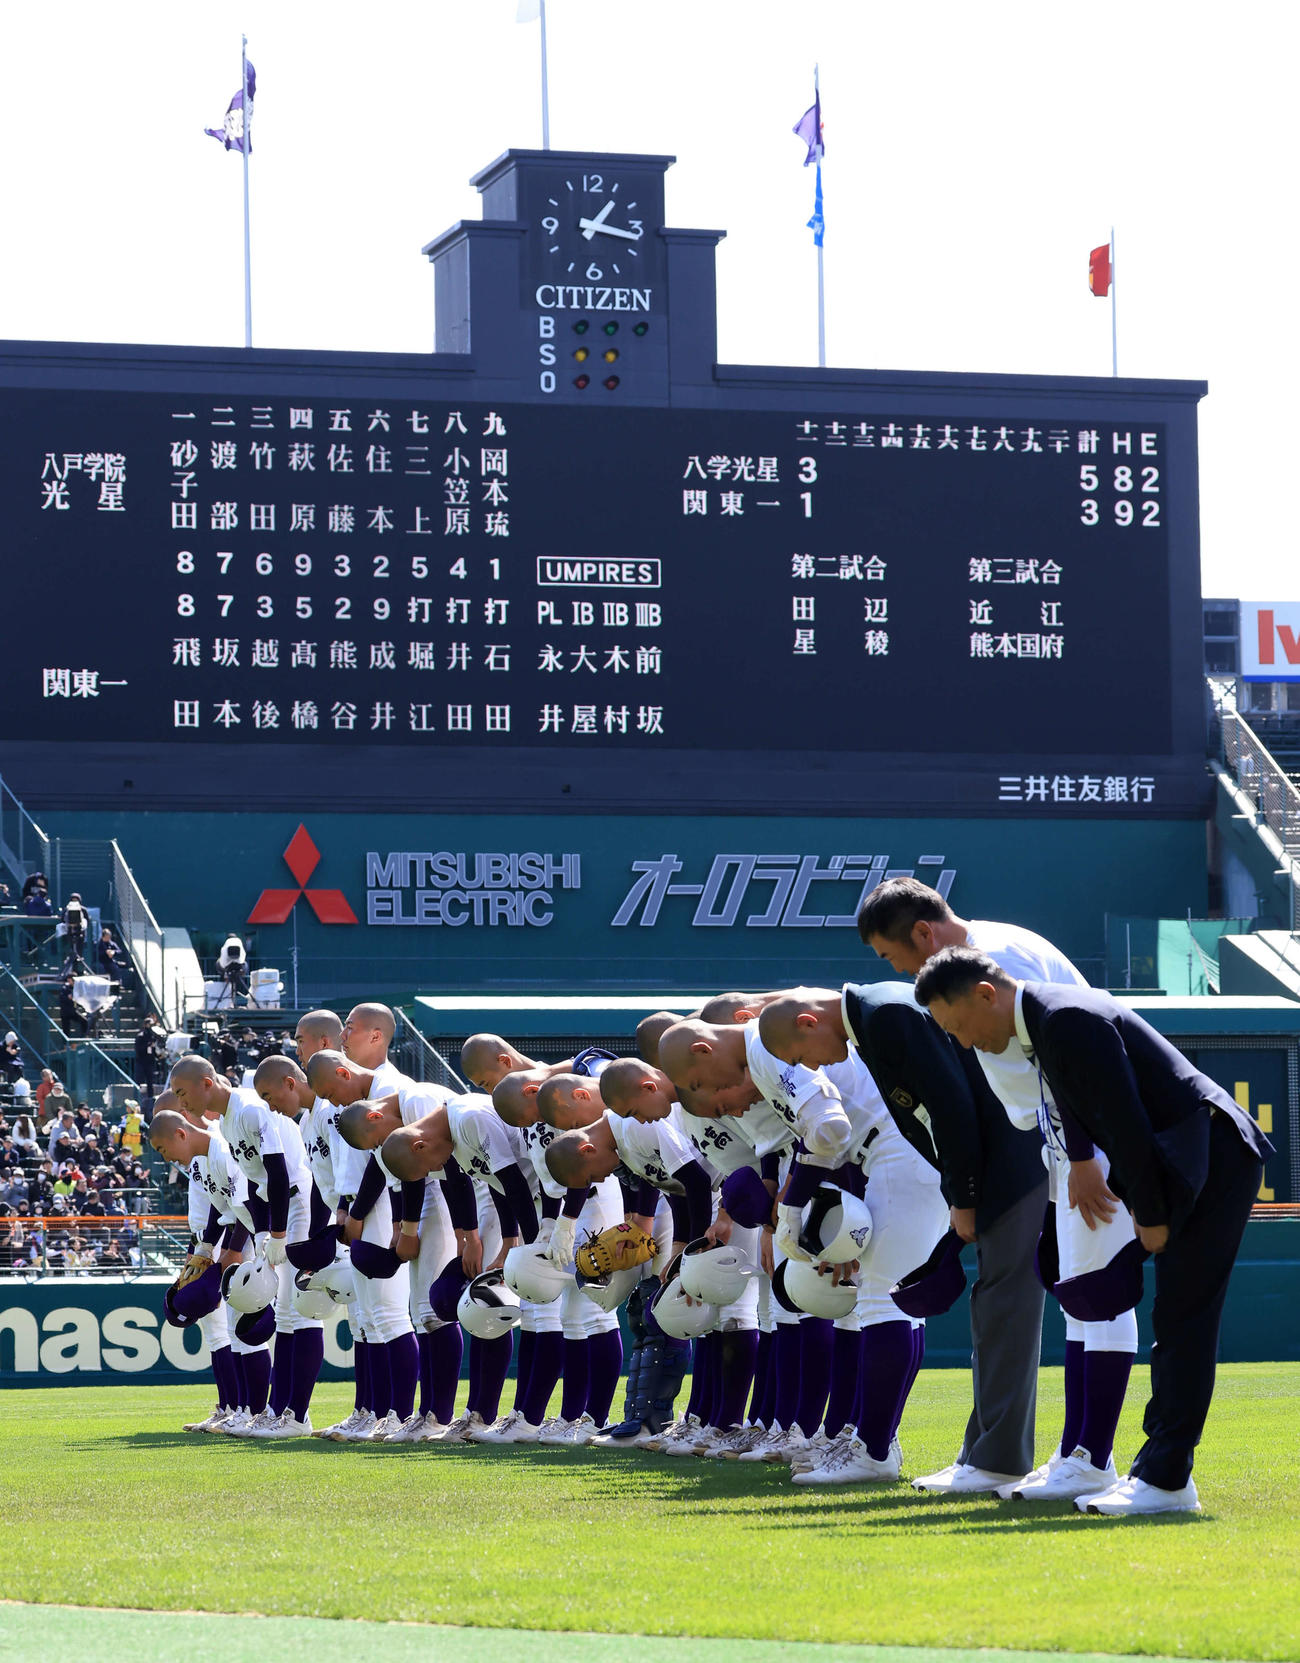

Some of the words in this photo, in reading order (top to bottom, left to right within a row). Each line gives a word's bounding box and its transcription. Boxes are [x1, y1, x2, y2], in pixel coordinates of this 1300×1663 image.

[583, 175, 603, 192] 12
[542, 217, 558, 235] 9
[628, 220, 644, 238] 3
[586, 263, 603, 280] 6
[536, 285, 651, 311] CITIZEN
[540, 316, 554, 338] B
[540, 344, 556, 365] S
[212, 407, 235, 425] 二
[251, 407, 274, 428] 三
[290, 408, 313, 429] 四
[329, 409, 352, 431] 五
[368, 410, 390, 431] 六
[407, 411, 429, 433] 七
[445, 412, 467, 433] 八
[483, 412, 506, 435] 九
[1079, 430, 1100, 453] 計
[1113, 432, 1131, 454] H
[1141, 433, 1157, 455] E
[41, 453, 126, 482] 八戸学院
[684, 456, 779, 482] 八学光星
[799, 457, 817, 483] 3
[1080, 465, 1098, 491] 5
[1114, 466, 1133, 492] 8
[1142, 467, 1159, 492] 2
[42, 481, 125, 511] 光星
[170, 440, 198, 529] 砂子田
[211, 441, 238, 530] 渡部
[250, 442, 275, 531] 竹田
[289, 443, 315, 531] 萩原
[328, 444, 354, 532] 佐藤
[366, 445, 393, 533] 住本
[406, 447, 432, 533] 三上
[444, 447, 470, 535] 小笠原
[481, 448, 509, 536] 岡本琉
[684, 490, 780, 515] 関東一
[801, 492, 811, 517] 1
[1081, 499, 1099, 525] 3
[1115, 500, 1133, 526] 9
[1142, 501, 1160, 526] 2
[177, 551, 194, 573] 8
[217, 552, 233, 574] 7
[256, 553, 272, 575] 6
[295, 554, 311, 575] 9
[335, 555, 350, 576] 3
[373, 556, 389, 577] 2
[412, 557, 428, 578] 5
[450, 558, 467, 579] 4
[490, 559, 499, 579] 1
[546, 562, 652, 583] UMPIRES
[792, 554, 887, 580] 第二試合
[969, 558, 1062, 584] 第三試合
[178, 594, 195, 616] 8
[217, 595, 233, 616] 7
[257, 596, 273, 617] 3
[296, 597, 312, 618] 5
[335, 597, 351, 619] 2
[374, 598, 390, 619] 9
[408, 597, 432, 623] 打
[446, 598, 471, 623] 打
[485, 598, 509, 624] 打
[538, 601, 562, 624] PL
[793, 597, 888, 622] 田辺
[970, 600, 1063, 626] 近江
[794, 629, 888, 655] 星稜
[970, 632, 1064, 658] 熊本国府
[43, 669, 127, 698] 関東一
[173, 638, 200, 727] 飛田
[213, 639, 240, 728] 坂本
[252, 639, 279, 728] 越後
[330, 641, 357, 729] 熊谷
[370, 642, 395, 730] 成井
[408, 642, 434, 730] 堀江
[447, 643, 472, 731] 井田
[485, 645, 510, 731] 石田
[538, 644, 564, 732] 永井
[571, 645, 597, 733] 大屋
[604, 646, 630, 733] 木村
[636, 646, 663, 733] 前坂
[999, 775, 1155, 802] 三井住友銀行
[366, 852, 581, 888] MITSUBISHI
[366, 889, 554, 927] ELECTRIC
